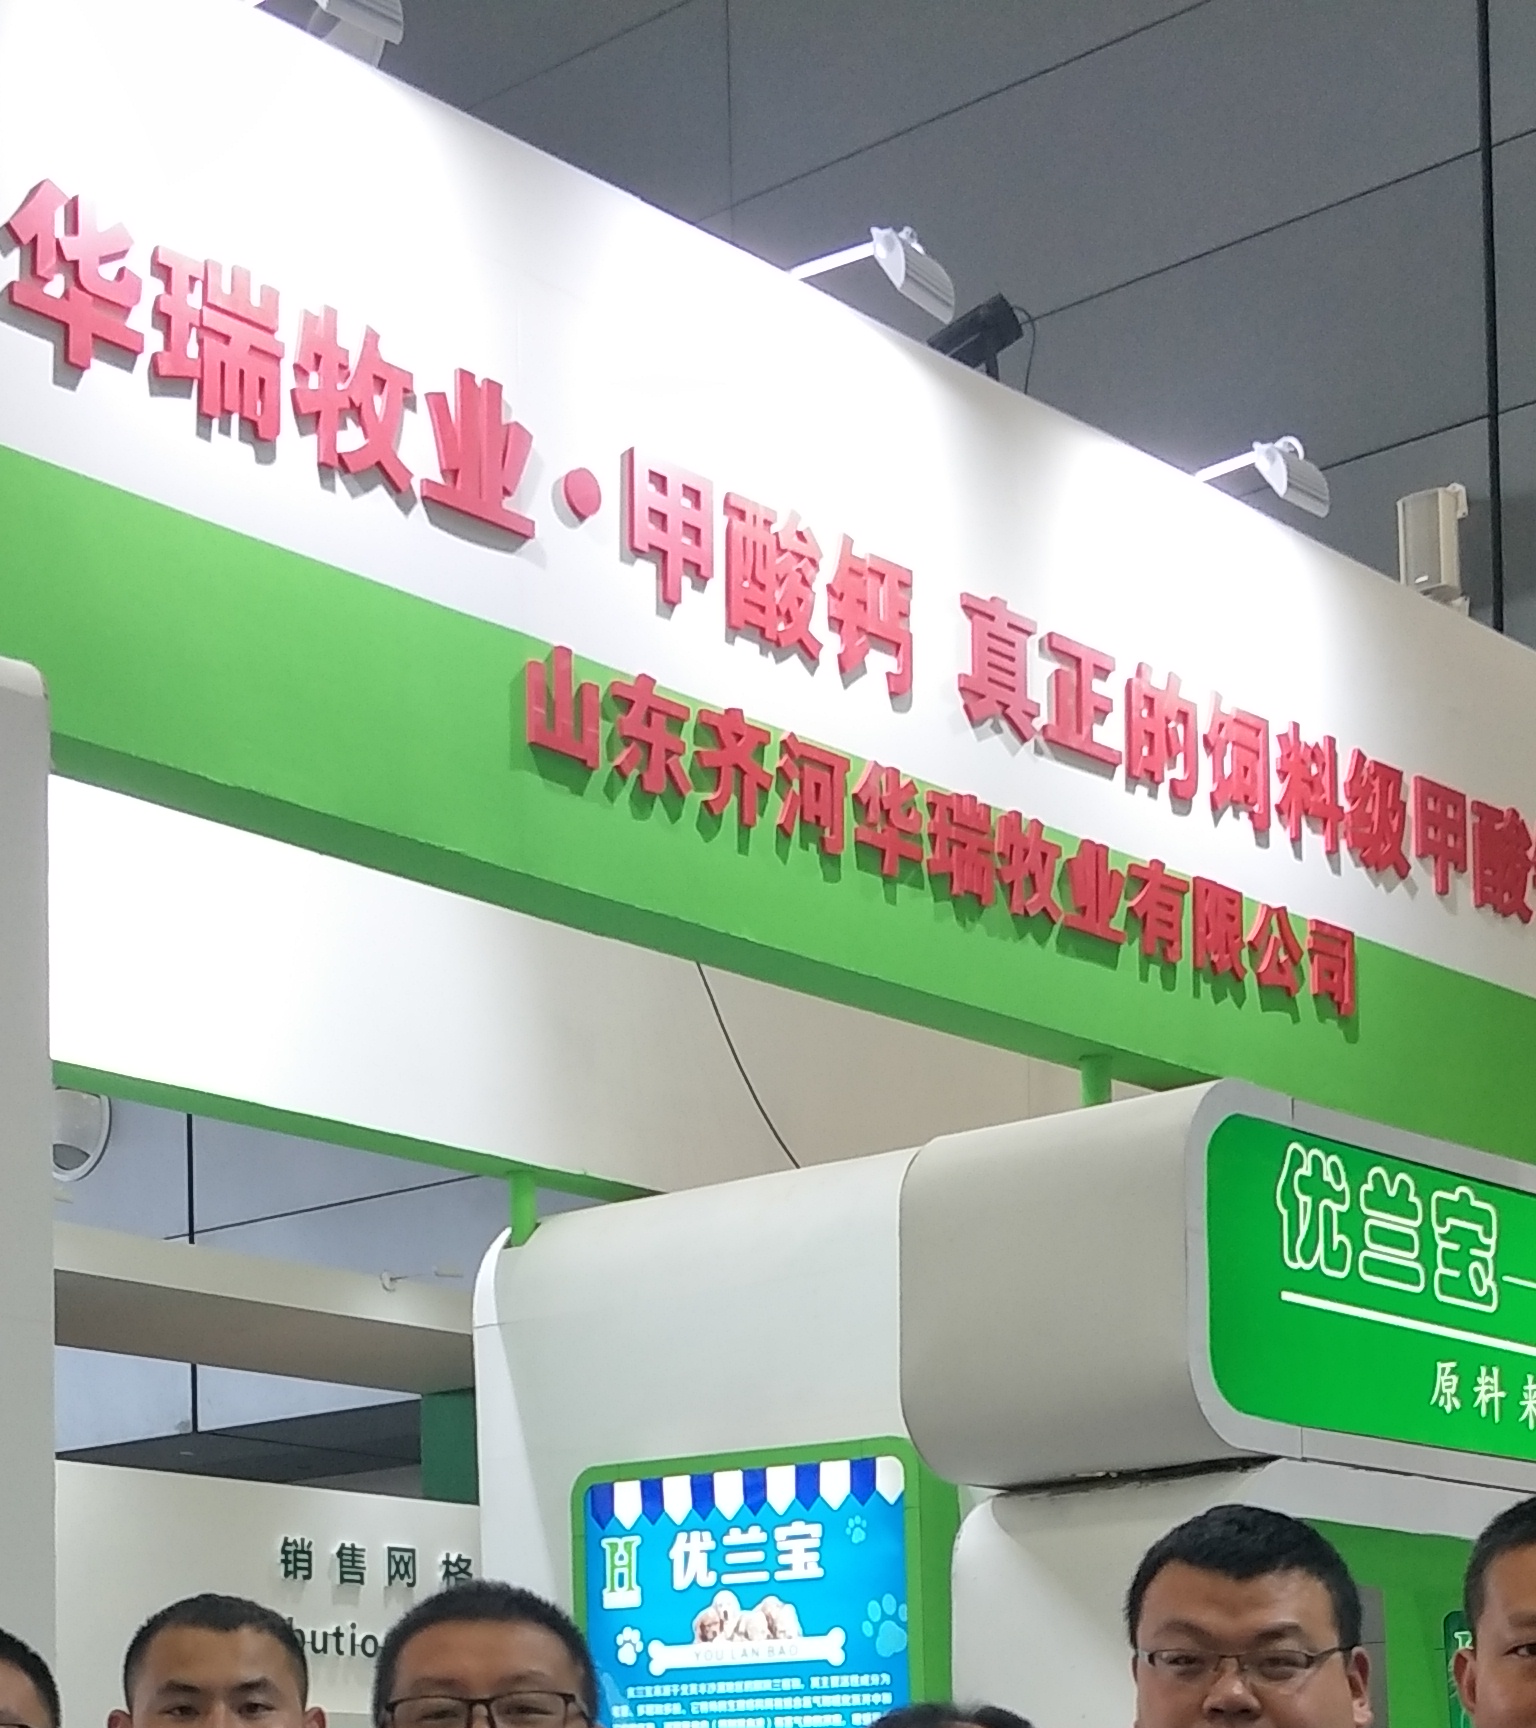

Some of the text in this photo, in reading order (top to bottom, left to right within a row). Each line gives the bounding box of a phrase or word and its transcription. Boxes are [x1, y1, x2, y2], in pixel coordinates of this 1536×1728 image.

[527, 645, 1356, 1018] 山东齐河华瑞牧业有限公司
[280, 1536, 473, 1587] 销售网格
[669, 1520, 825, 1592] 优兰宝
[694, 1644, 799, 1662] YOU LAN BAO
